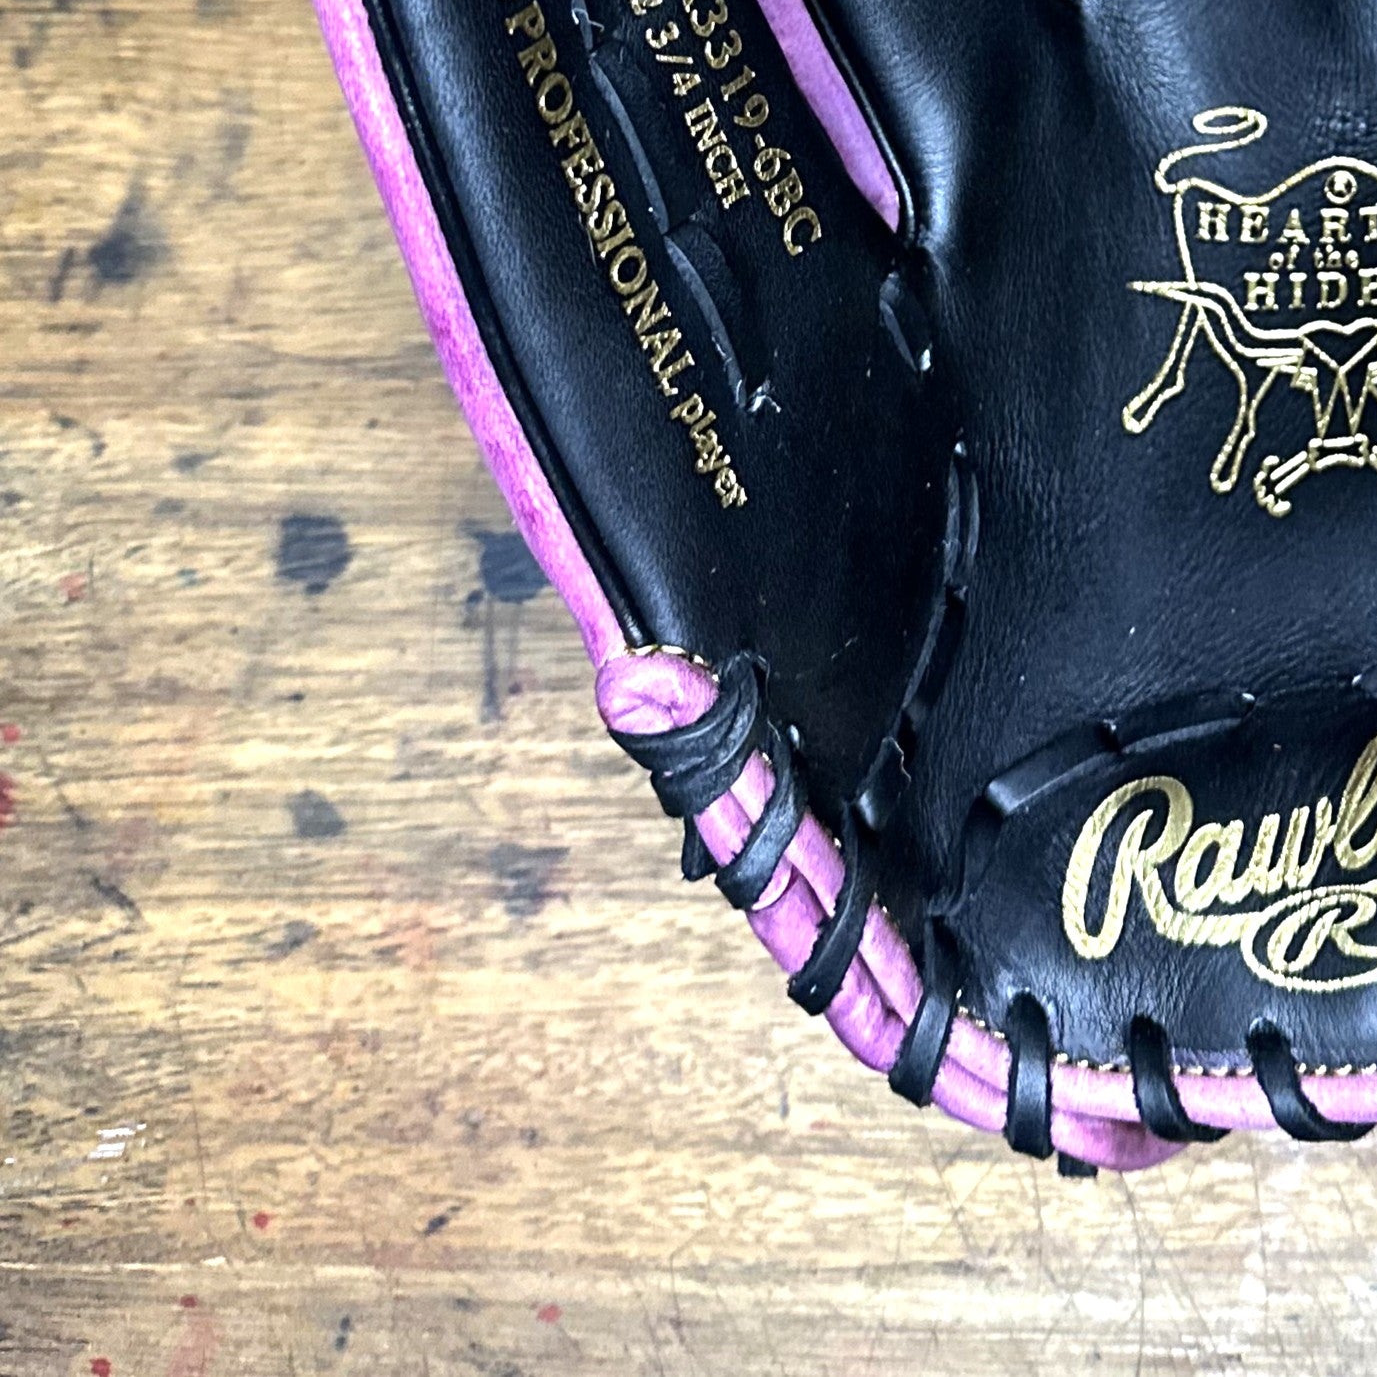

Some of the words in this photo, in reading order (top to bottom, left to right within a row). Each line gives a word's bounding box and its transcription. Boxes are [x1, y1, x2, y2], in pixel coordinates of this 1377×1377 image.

[645, 21, 702, 97] 3/4
[684, 98, 751, 210] INCH
[505, 0, 696, 397] PROFESSIONAL
[669, 393, 748, 509] player
[1269, 244, 1300, 270] of
[1313, 246, 1359, 269] the
